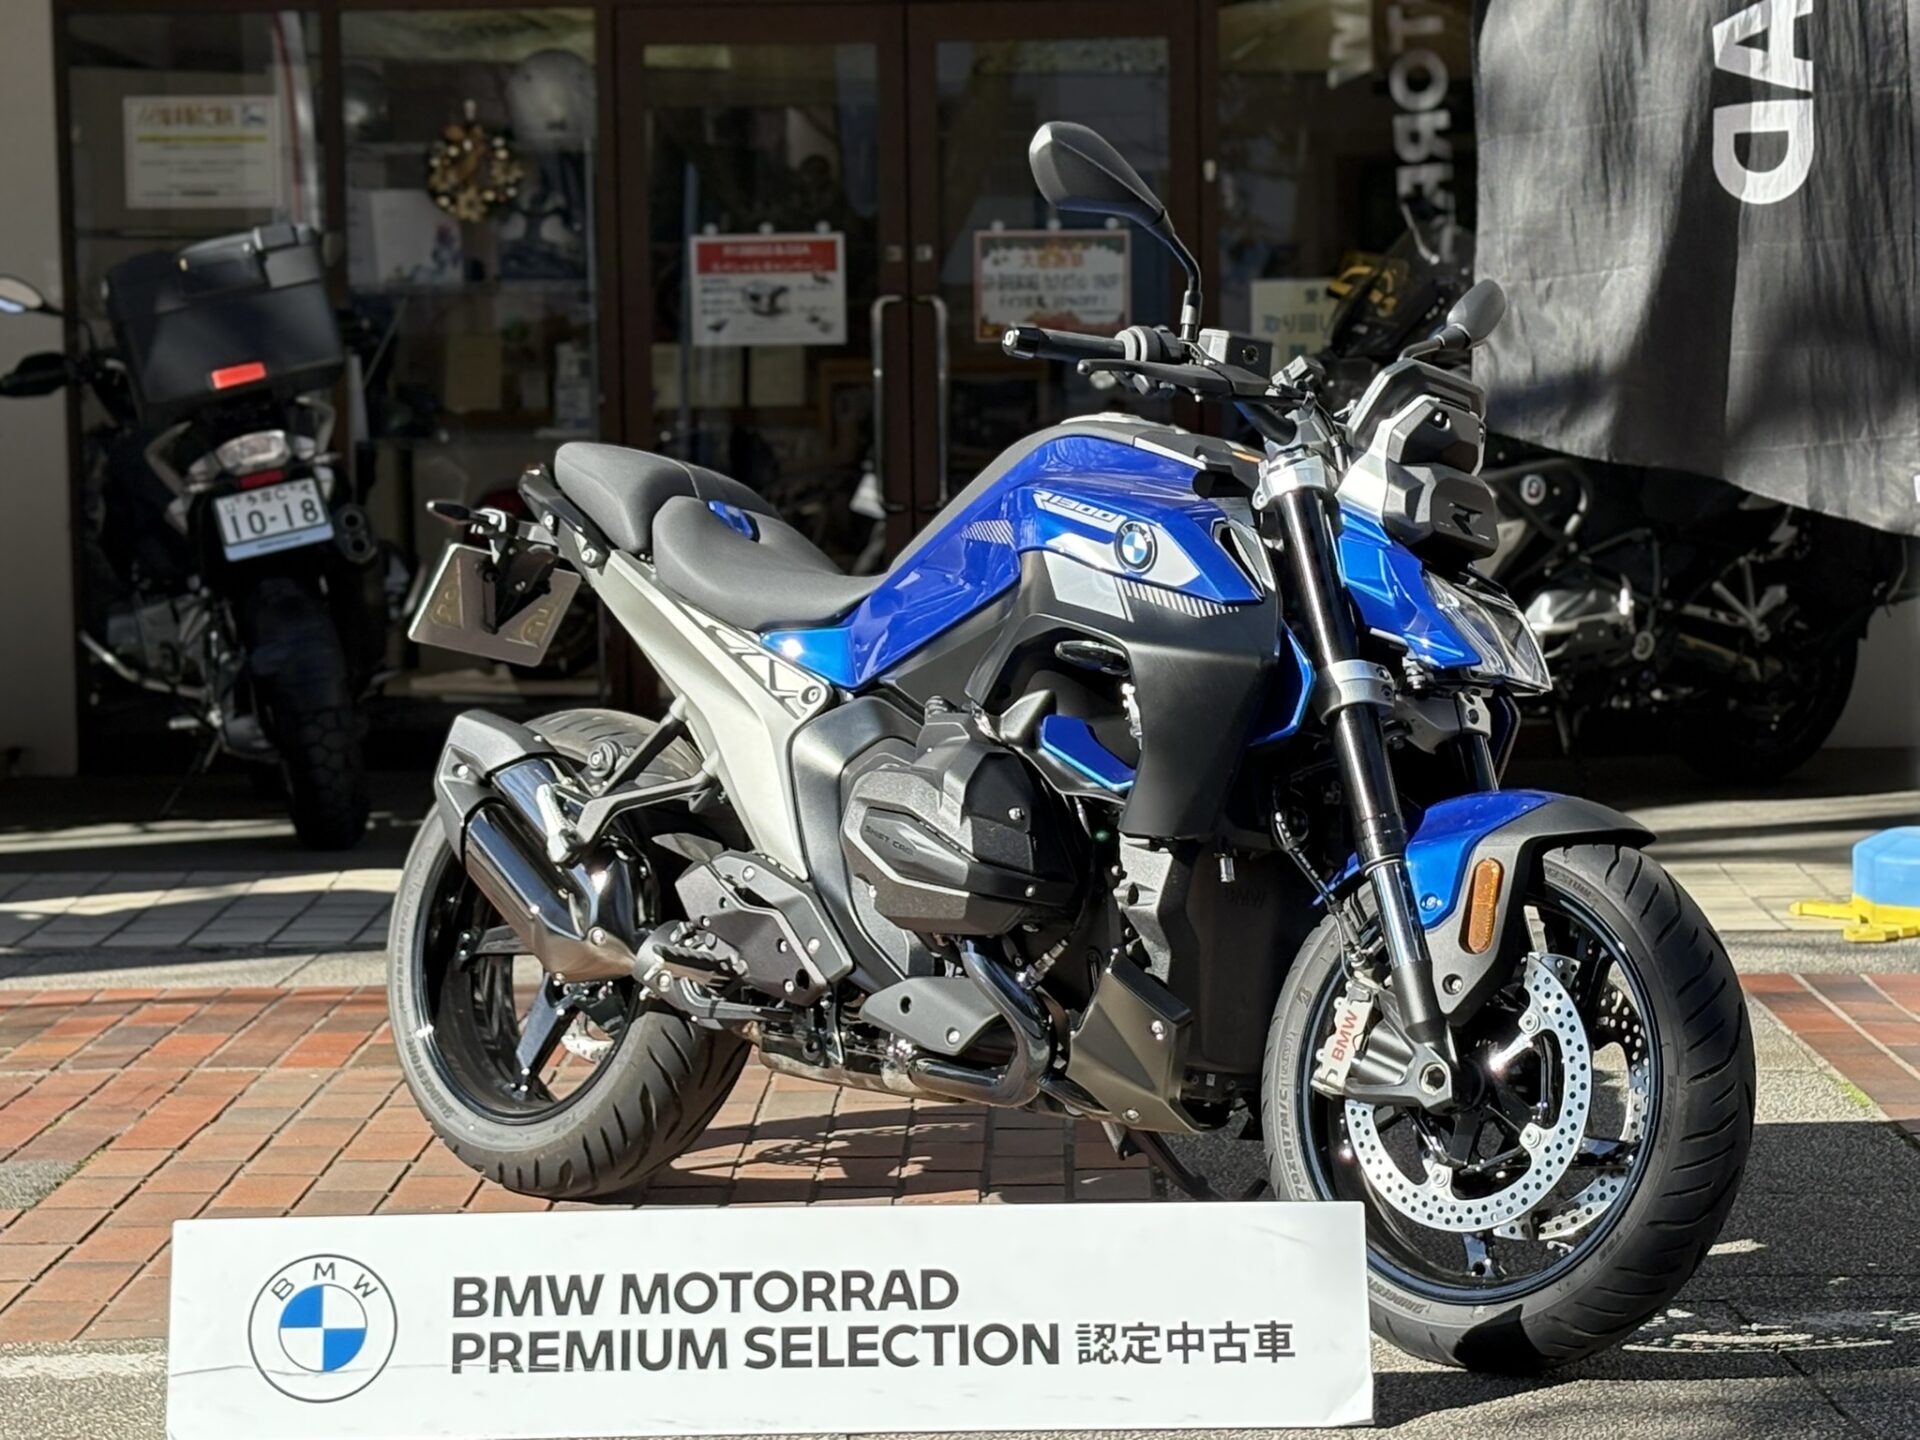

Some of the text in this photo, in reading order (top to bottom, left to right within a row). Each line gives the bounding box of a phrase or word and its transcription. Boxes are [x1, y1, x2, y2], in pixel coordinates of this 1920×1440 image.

[230, 498, 319, 540] 10-18
[1330, 1009, 1358, 1062] BMW
[270, 1261, 379, 1301] BMW
[454, 1270, 958, 1317] BMW MOTORRAD
[453, 1321, 1294, 1373] PREMIUM SELECTION 認定中古車
